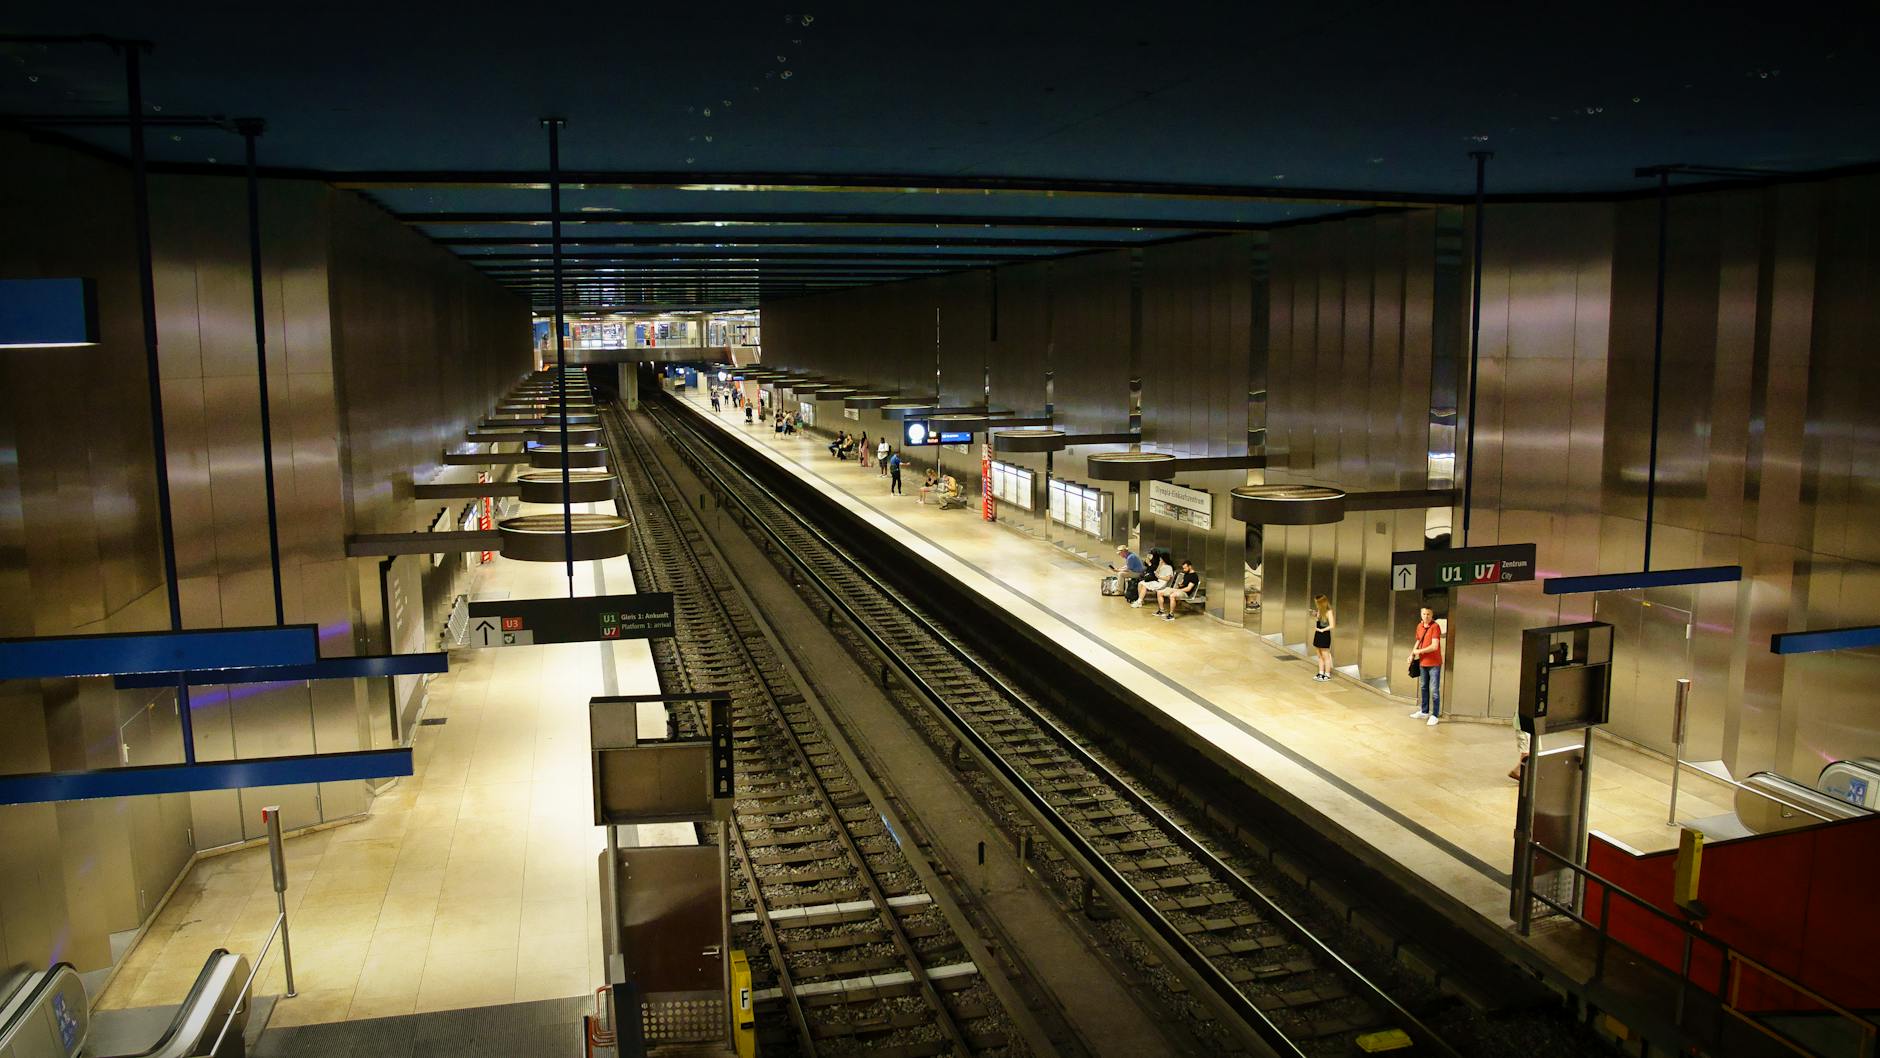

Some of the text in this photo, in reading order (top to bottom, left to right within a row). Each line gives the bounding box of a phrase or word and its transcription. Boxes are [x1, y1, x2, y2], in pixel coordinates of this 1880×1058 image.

[1502, 560, 1527, 568] Zentrum
[1442, 564, 1494, 582] U1 U7
[1501, 572, 1512, 580] City
[506, 619, 518, 628] U3
[622, 622, 645, 630] Platform
[603, 627, 616, 636] U7
[741, 990, 748, 1008] F
